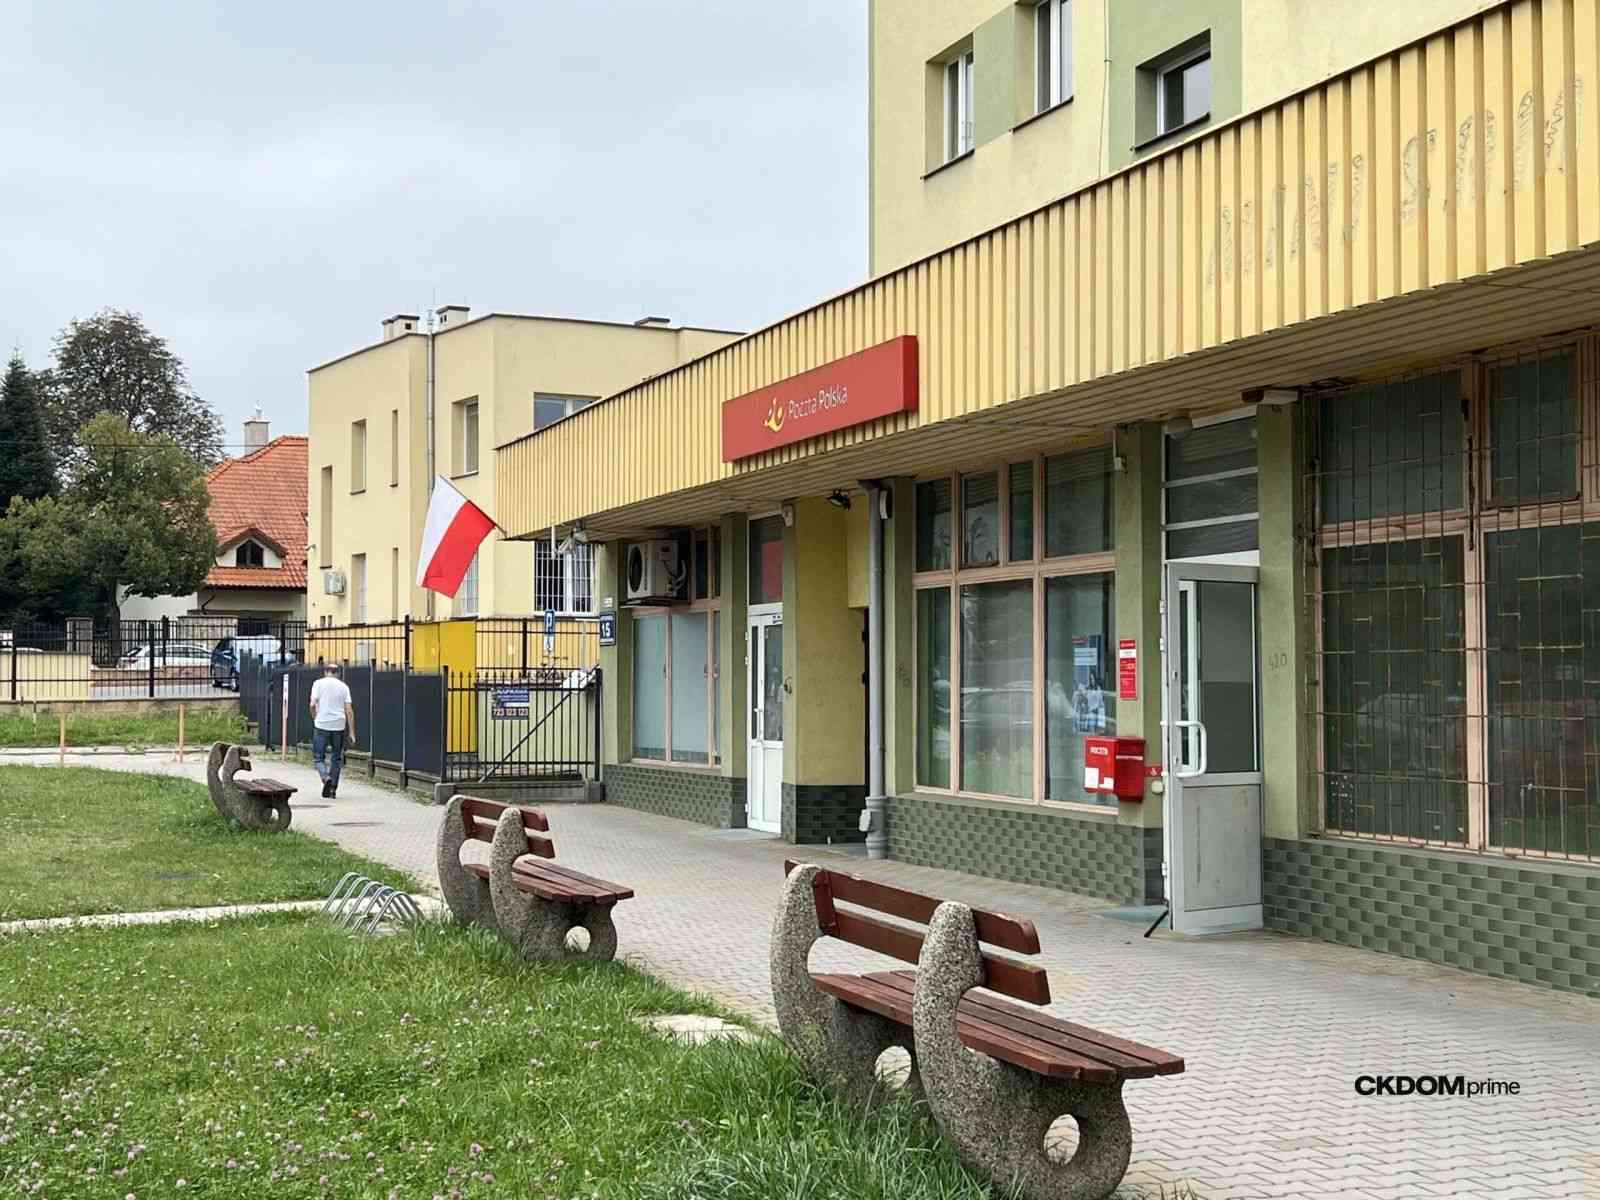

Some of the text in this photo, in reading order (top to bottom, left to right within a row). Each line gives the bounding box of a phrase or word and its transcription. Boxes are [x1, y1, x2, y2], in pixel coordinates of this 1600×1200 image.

[788, 385, 848, 418] Poczta Polska
[602, 622, 611, 637] 15
